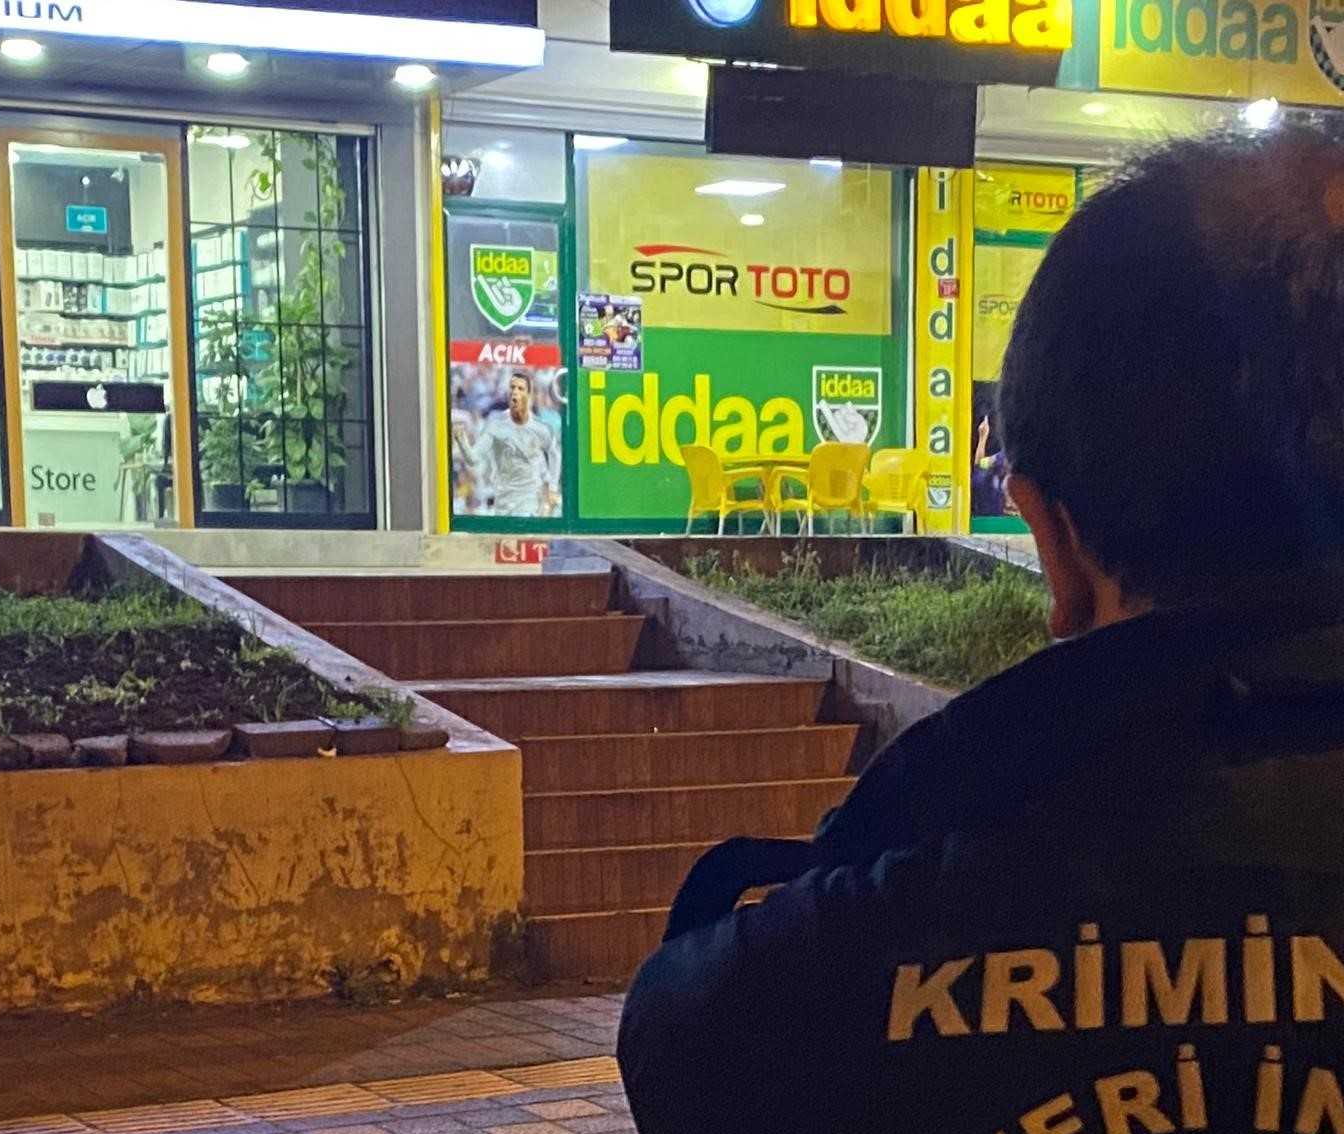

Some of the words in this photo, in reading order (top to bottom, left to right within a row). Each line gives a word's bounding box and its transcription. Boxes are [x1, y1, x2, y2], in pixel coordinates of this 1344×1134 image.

[1022, 191, 1069, 209] TOTO
[476, 250, 530, 275] iddaa
[630, 260, 739, 296] SPOR
[746, 264, 851, 301] TOTO
[478, 343, 528, 368] AÇIK
[820, 373, 875, 399] iddaa
[588, 370, 804, 466] iddaa
[31, 465, 97, 491] Store
